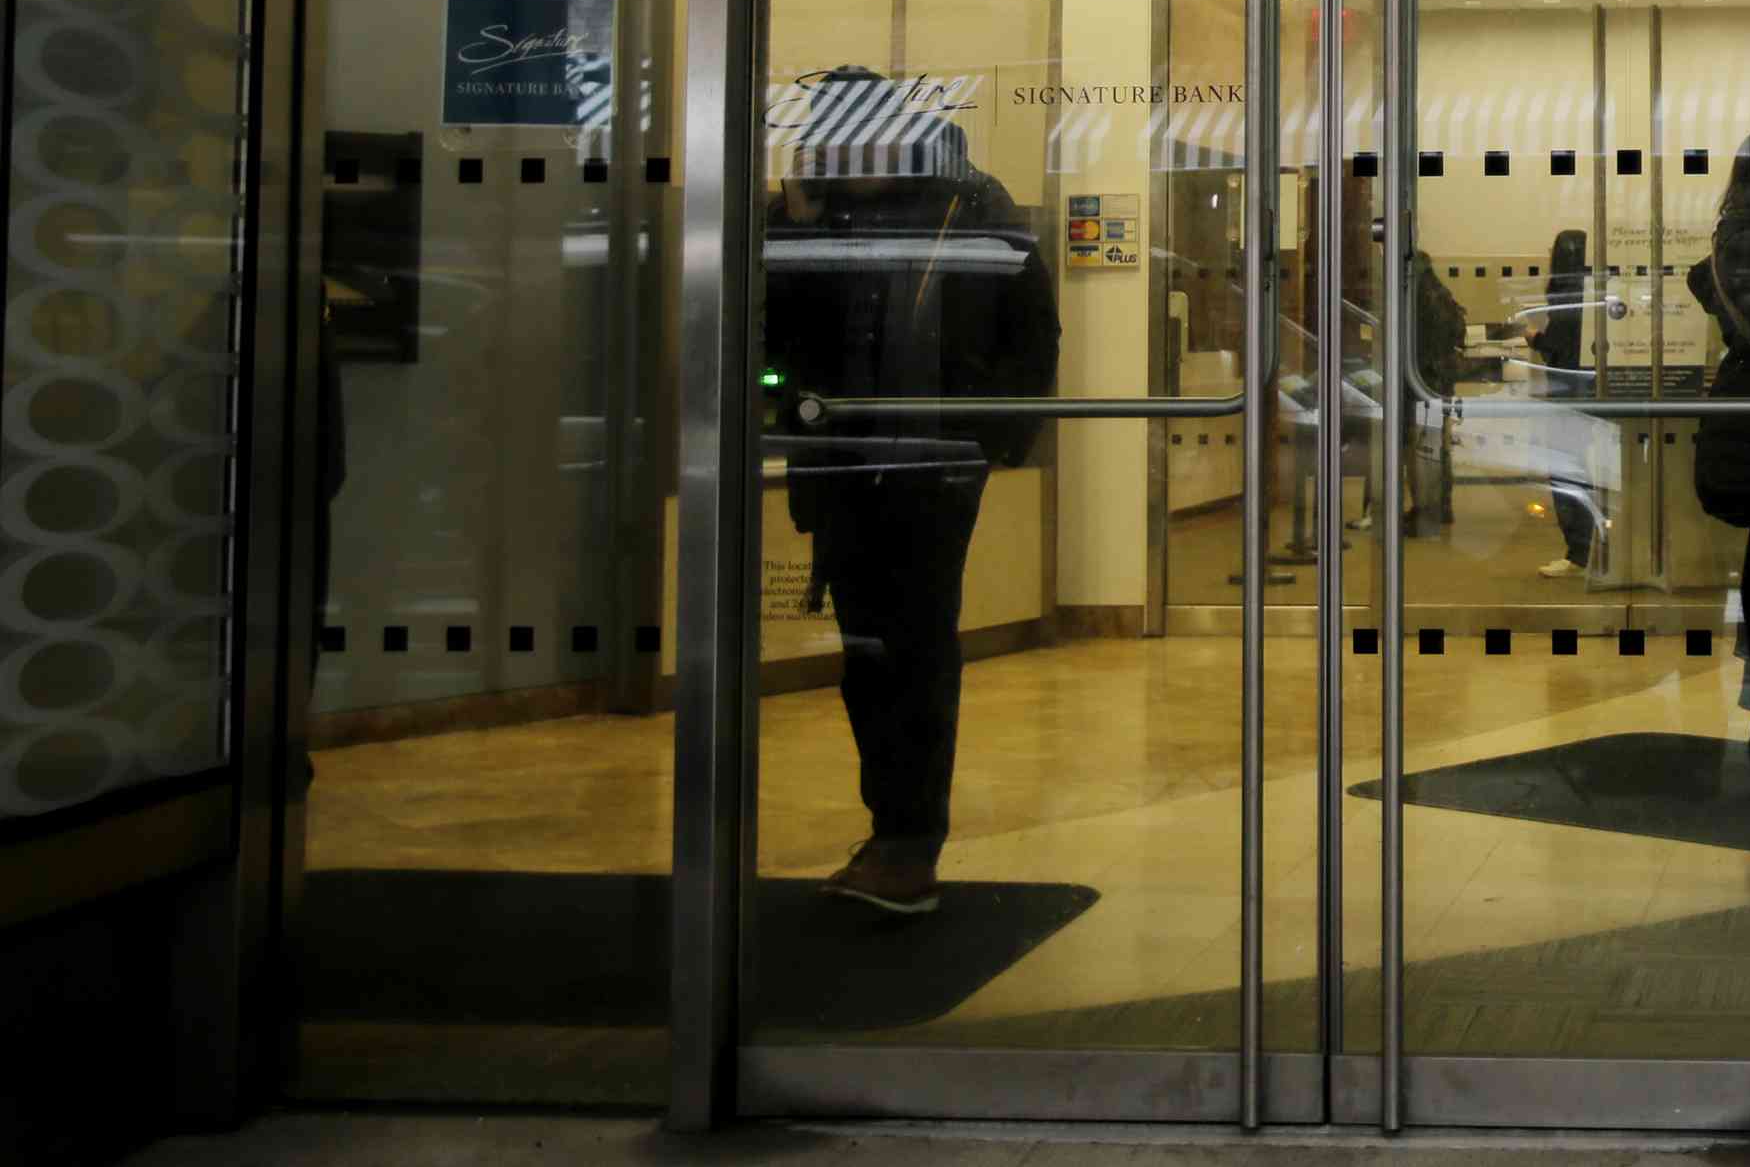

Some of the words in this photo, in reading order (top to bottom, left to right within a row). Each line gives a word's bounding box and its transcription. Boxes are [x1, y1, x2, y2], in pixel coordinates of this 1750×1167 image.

[456, 82, 549, 97] SIGNATURE
[1013, 85, 1164, 106] SIGNATURE
[1174, 84, 1245, 105] BANK
